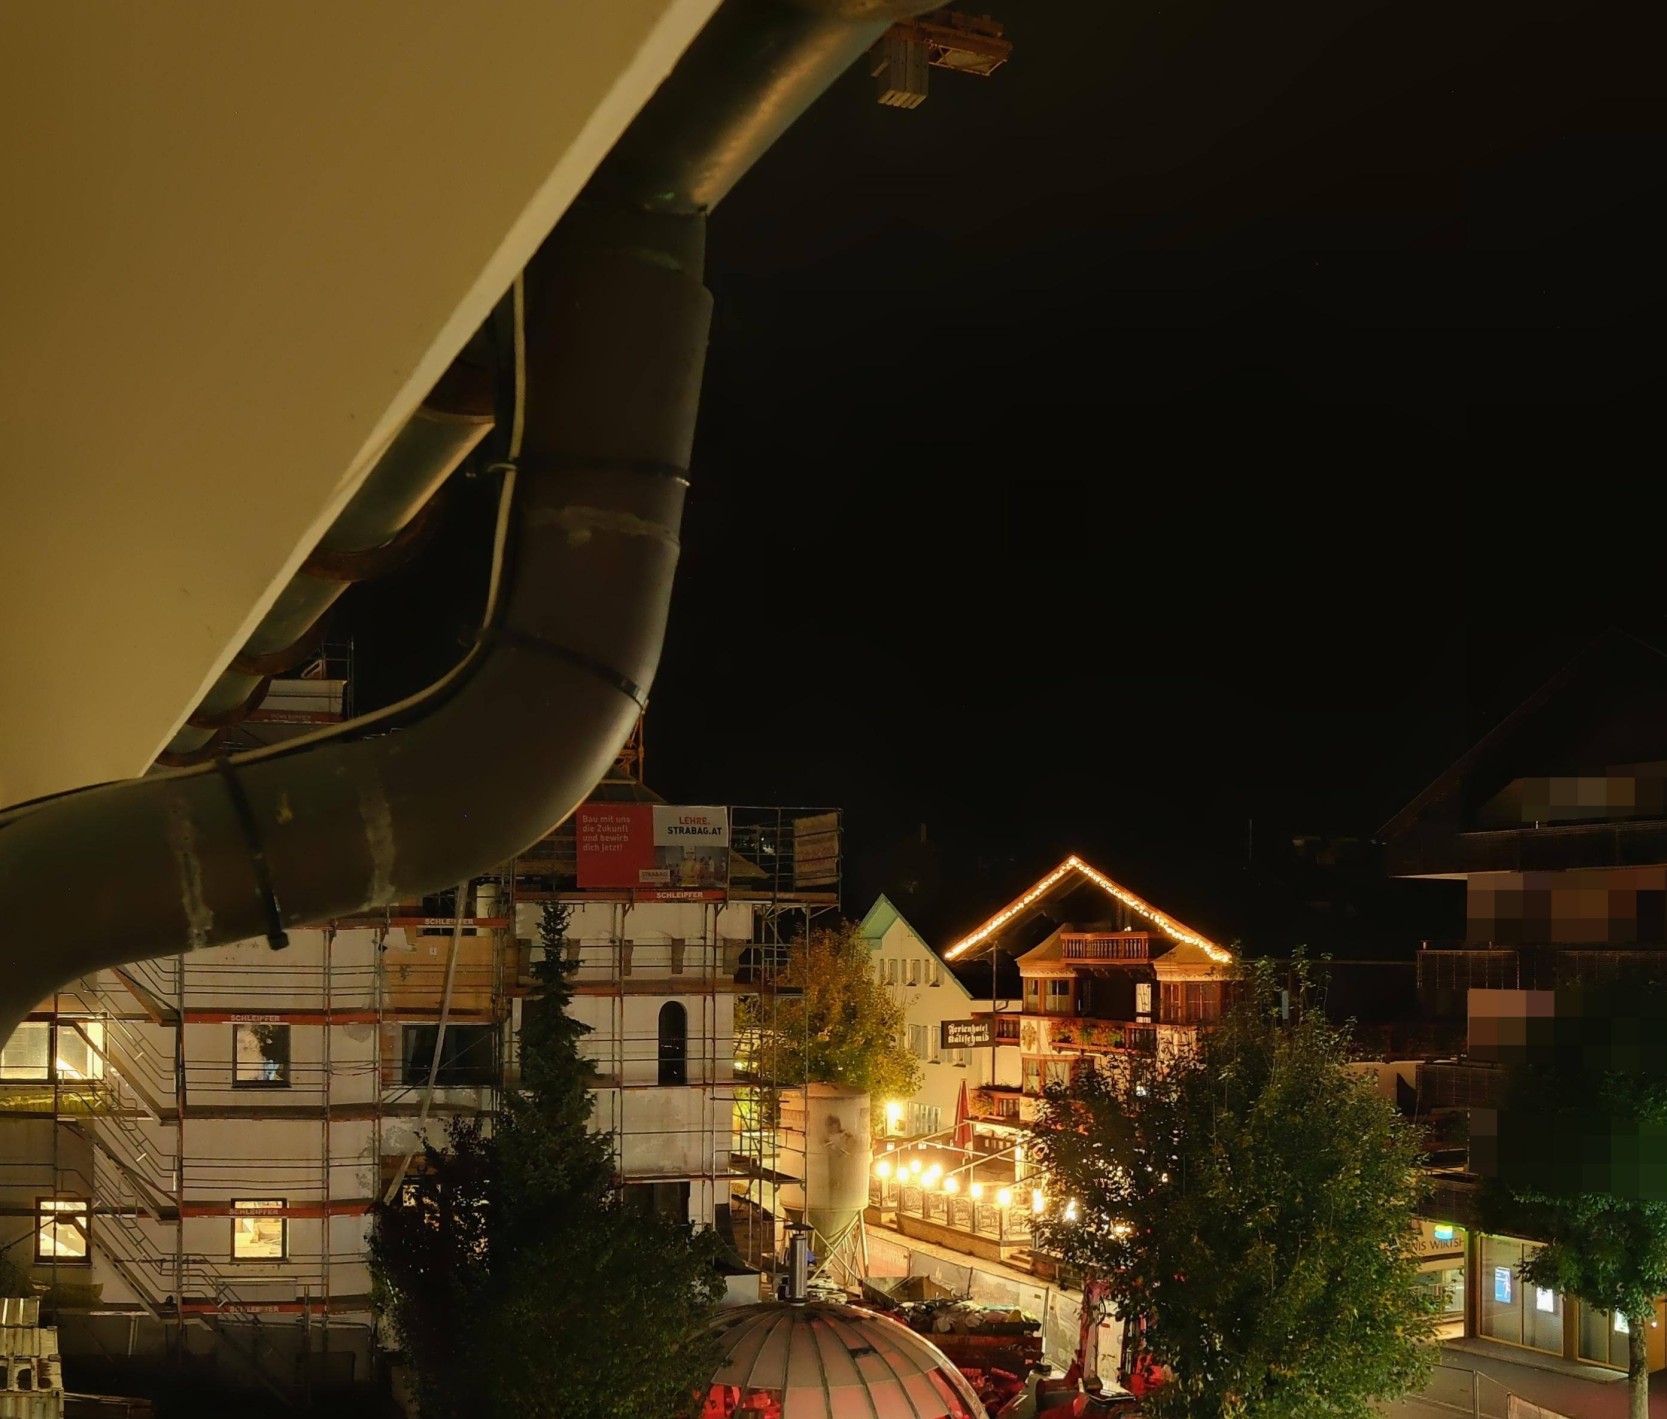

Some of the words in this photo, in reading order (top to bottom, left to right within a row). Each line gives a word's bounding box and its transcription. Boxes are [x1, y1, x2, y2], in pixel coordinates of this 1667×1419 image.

[678, 816, 711, 825] LEHRE.
[667, 826, 722, 836] STRABAG.AT
[656, 891, 703, 899] SCHLEIPFER
[230, 1014, 281, 1022] SCHLEIPFER
[229, 1208, 279, 1216] SCHLEIPFER
